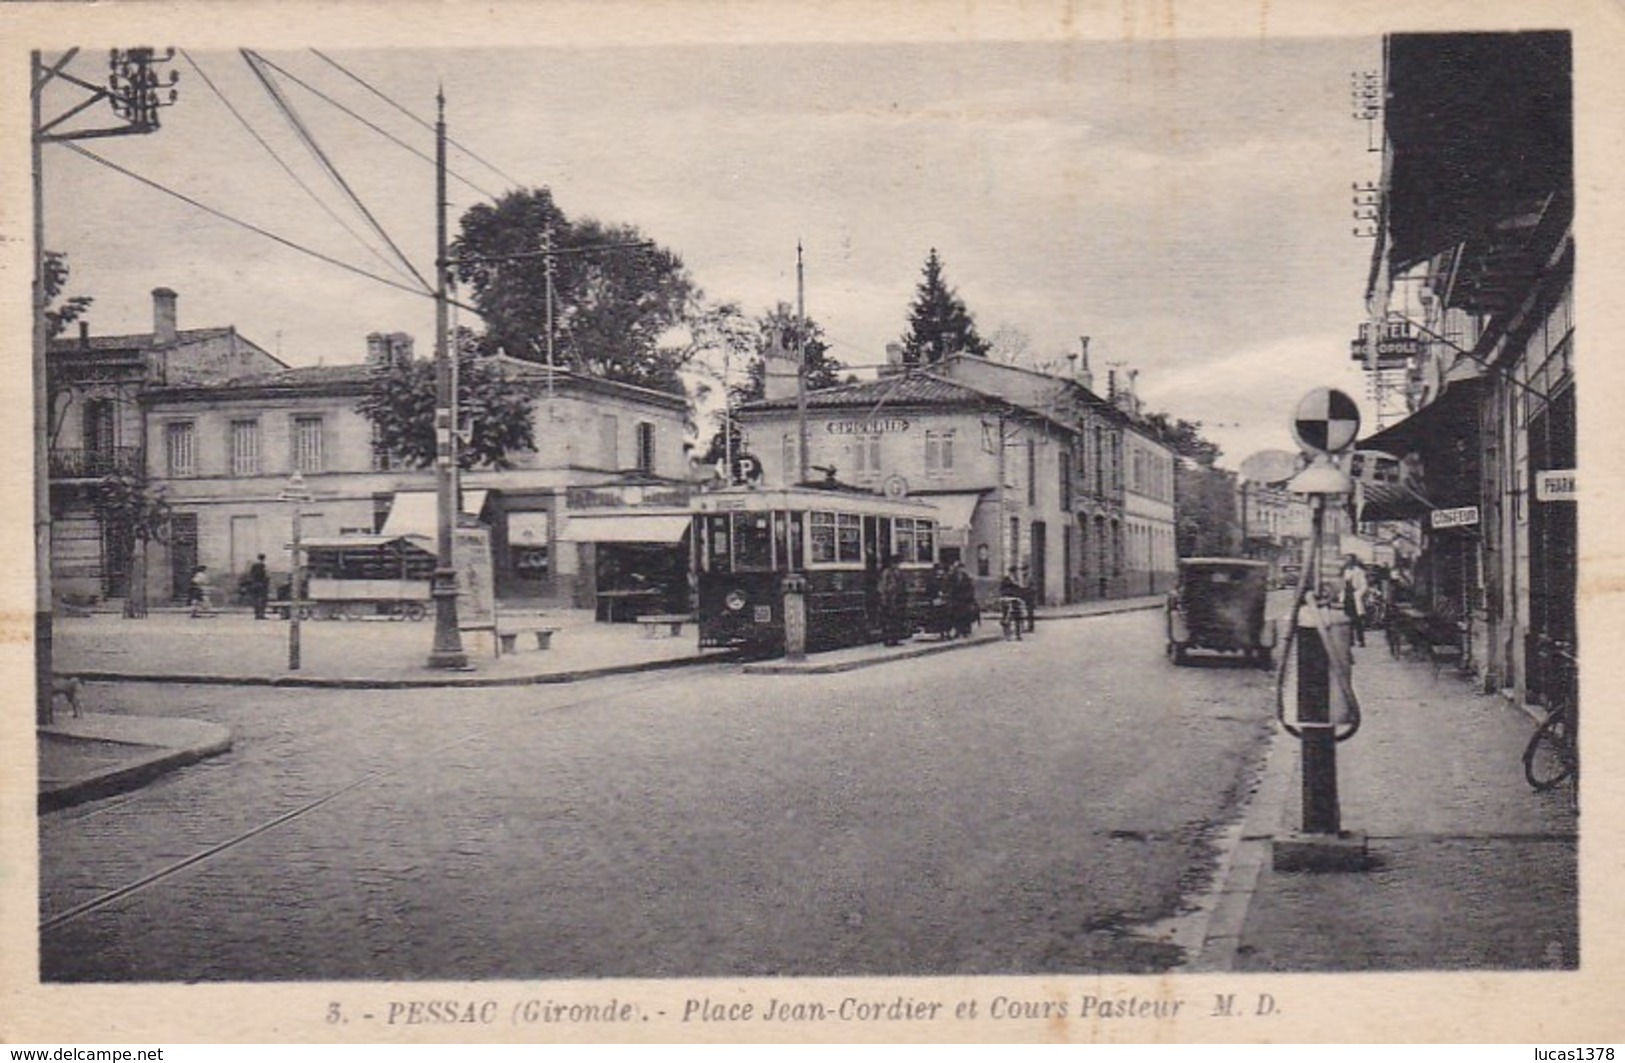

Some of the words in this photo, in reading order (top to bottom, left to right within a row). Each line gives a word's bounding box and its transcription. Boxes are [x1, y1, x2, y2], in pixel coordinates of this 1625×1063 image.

[1359, 322, 1410, 339] HTEL
[1351, 343, 1417, 356] MOOPOLE
[739, 459, 754, 480] P
[387, 1001, 497, 1025] PESSAC
[682, 998, 754, 1022] Place
[762, 997, 942, 1022] Jean-Cordier
[955, 999, 978, 1020] et
[990, 996, 1069, 1019] Cours
[1080, 995, 1185, 1019] Pasteur
